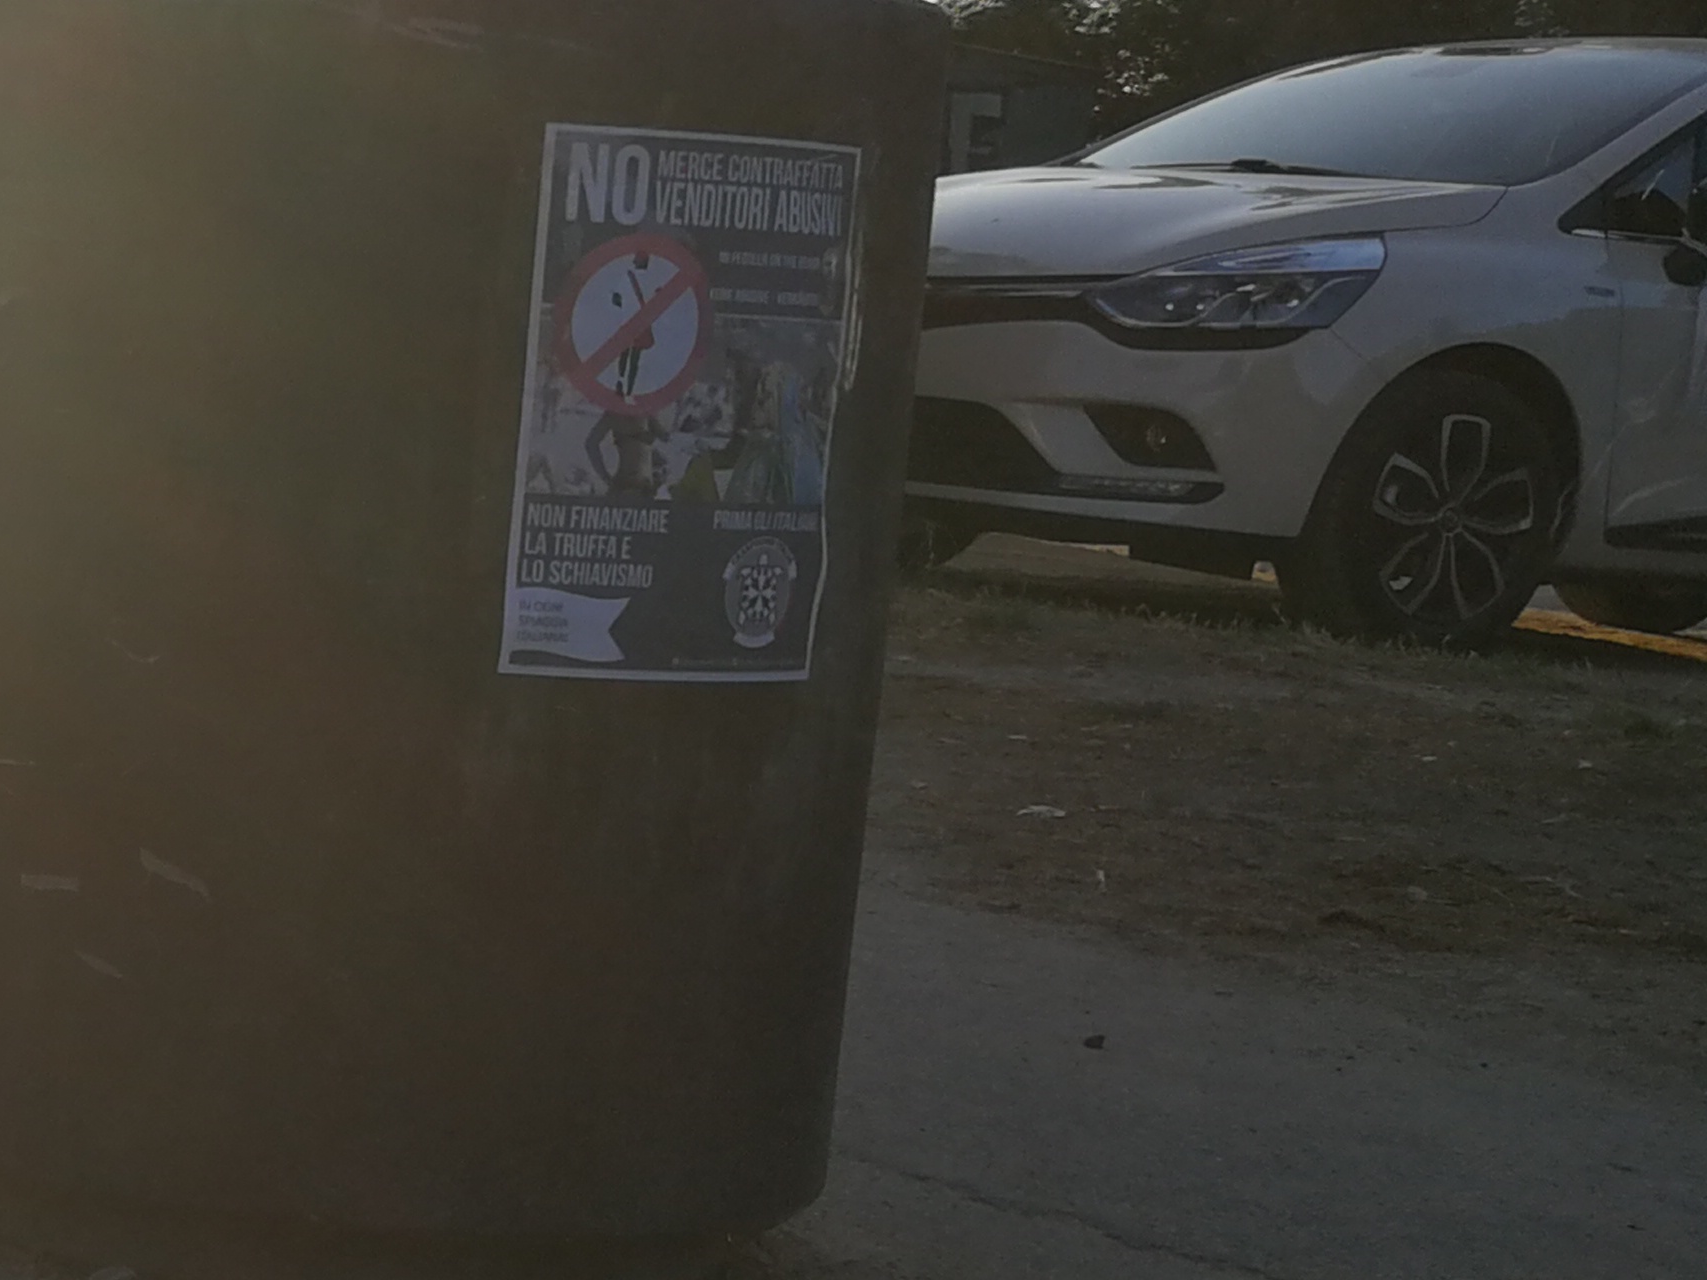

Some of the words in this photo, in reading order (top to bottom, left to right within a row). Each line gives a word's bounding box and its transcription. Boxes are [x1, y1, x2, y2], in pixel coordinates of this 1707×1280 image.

[564, 141, 650, 226] NO
[656, 149, 725, 183] MERCE
[727, 154, 843, 190] CONTRAFFATTA
[654, 180, 770, 232] VENDITORI
[773, 188, 843, 238] ABUSIVI
[526, 502, 566, 530] NON
[569, 505, 670, 535] FINANZIARE
[524, 531, 548, 555] LA
[552, 533, 619, 558] TRUFFA
[621, 536, 632, 560] E
[520, 558, 544, 585] LO
[548, 561, 654, 589] SCHIAVISMO
